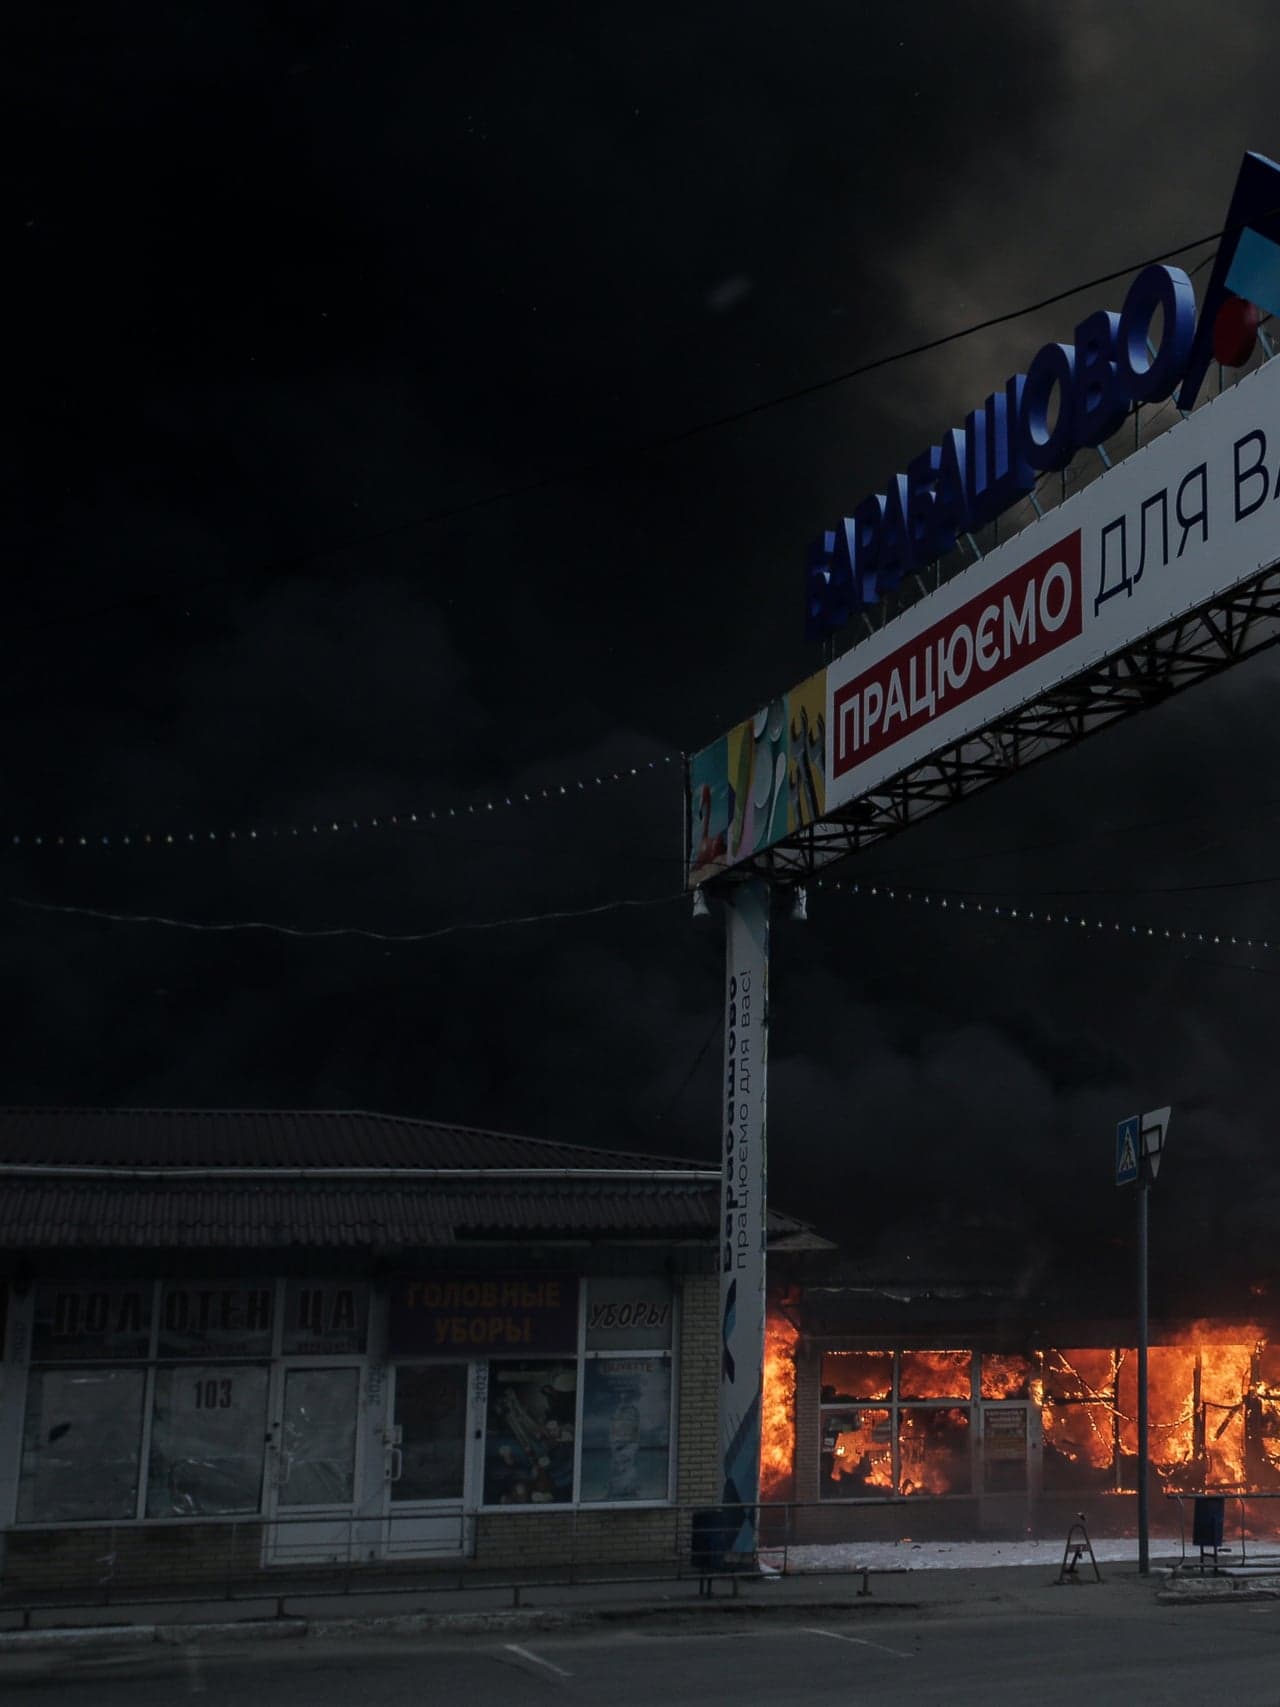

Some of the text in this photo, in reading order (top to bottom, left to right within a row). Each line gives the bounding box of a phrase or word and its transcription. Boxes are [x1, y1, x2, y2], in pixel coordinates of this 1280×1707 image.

[839, 560, 1073, 761] ПРАЦЮЄМО
[1094, 461, 1209, 617] ДЛЯ
[736, 969, 751, 1269] працюємо для вас!
[406, 1280, 561, 1310] ГОЛОВНЫЕ
[588, 1301, 671, 1329] УБОРЫ
[434, 1317, 533, 1345] УБОРЫ
[193, 1378, 233, 1410] 103
